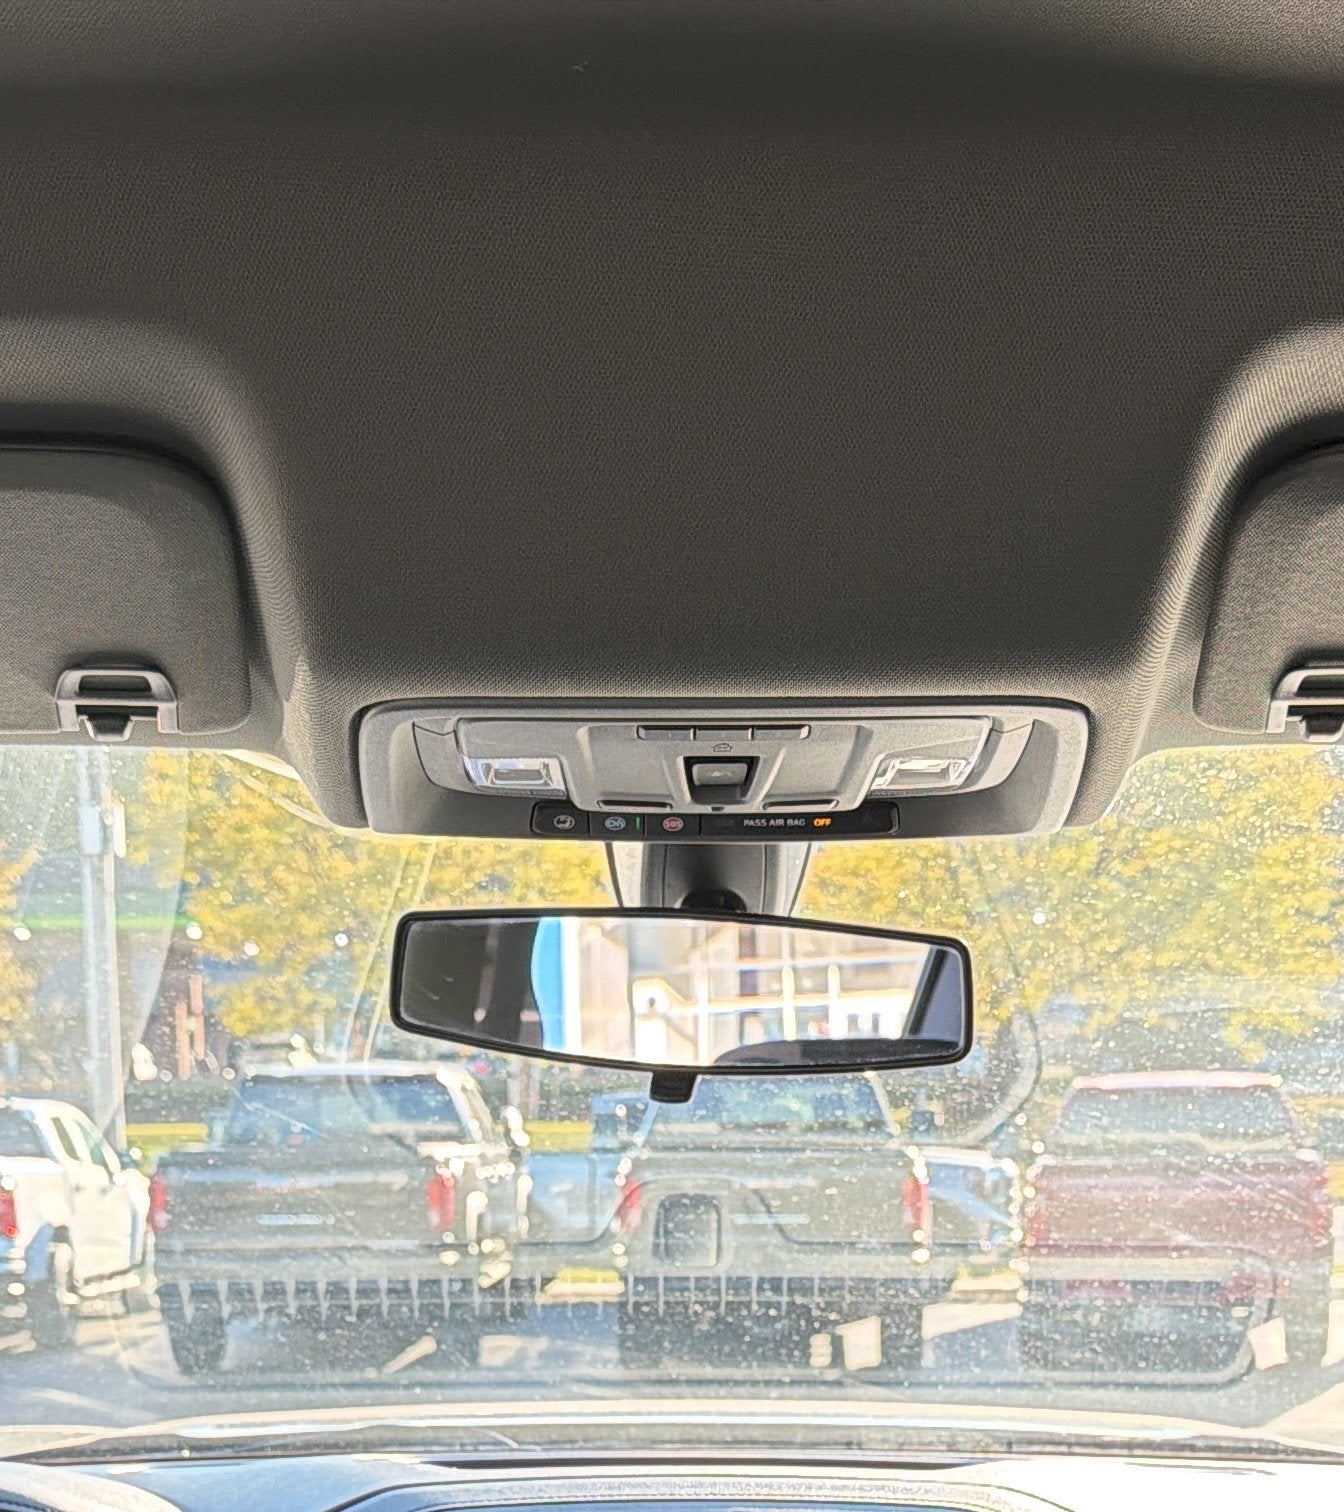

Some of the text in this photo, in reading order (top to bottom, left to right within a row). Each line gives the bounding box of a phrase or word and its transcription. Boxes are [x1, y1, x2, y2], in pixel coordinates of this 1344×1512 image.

[744, 819, 766, 827] PASS
[769, 819, 784, 827] AIR
[813, 818, 832, 827] OFF
